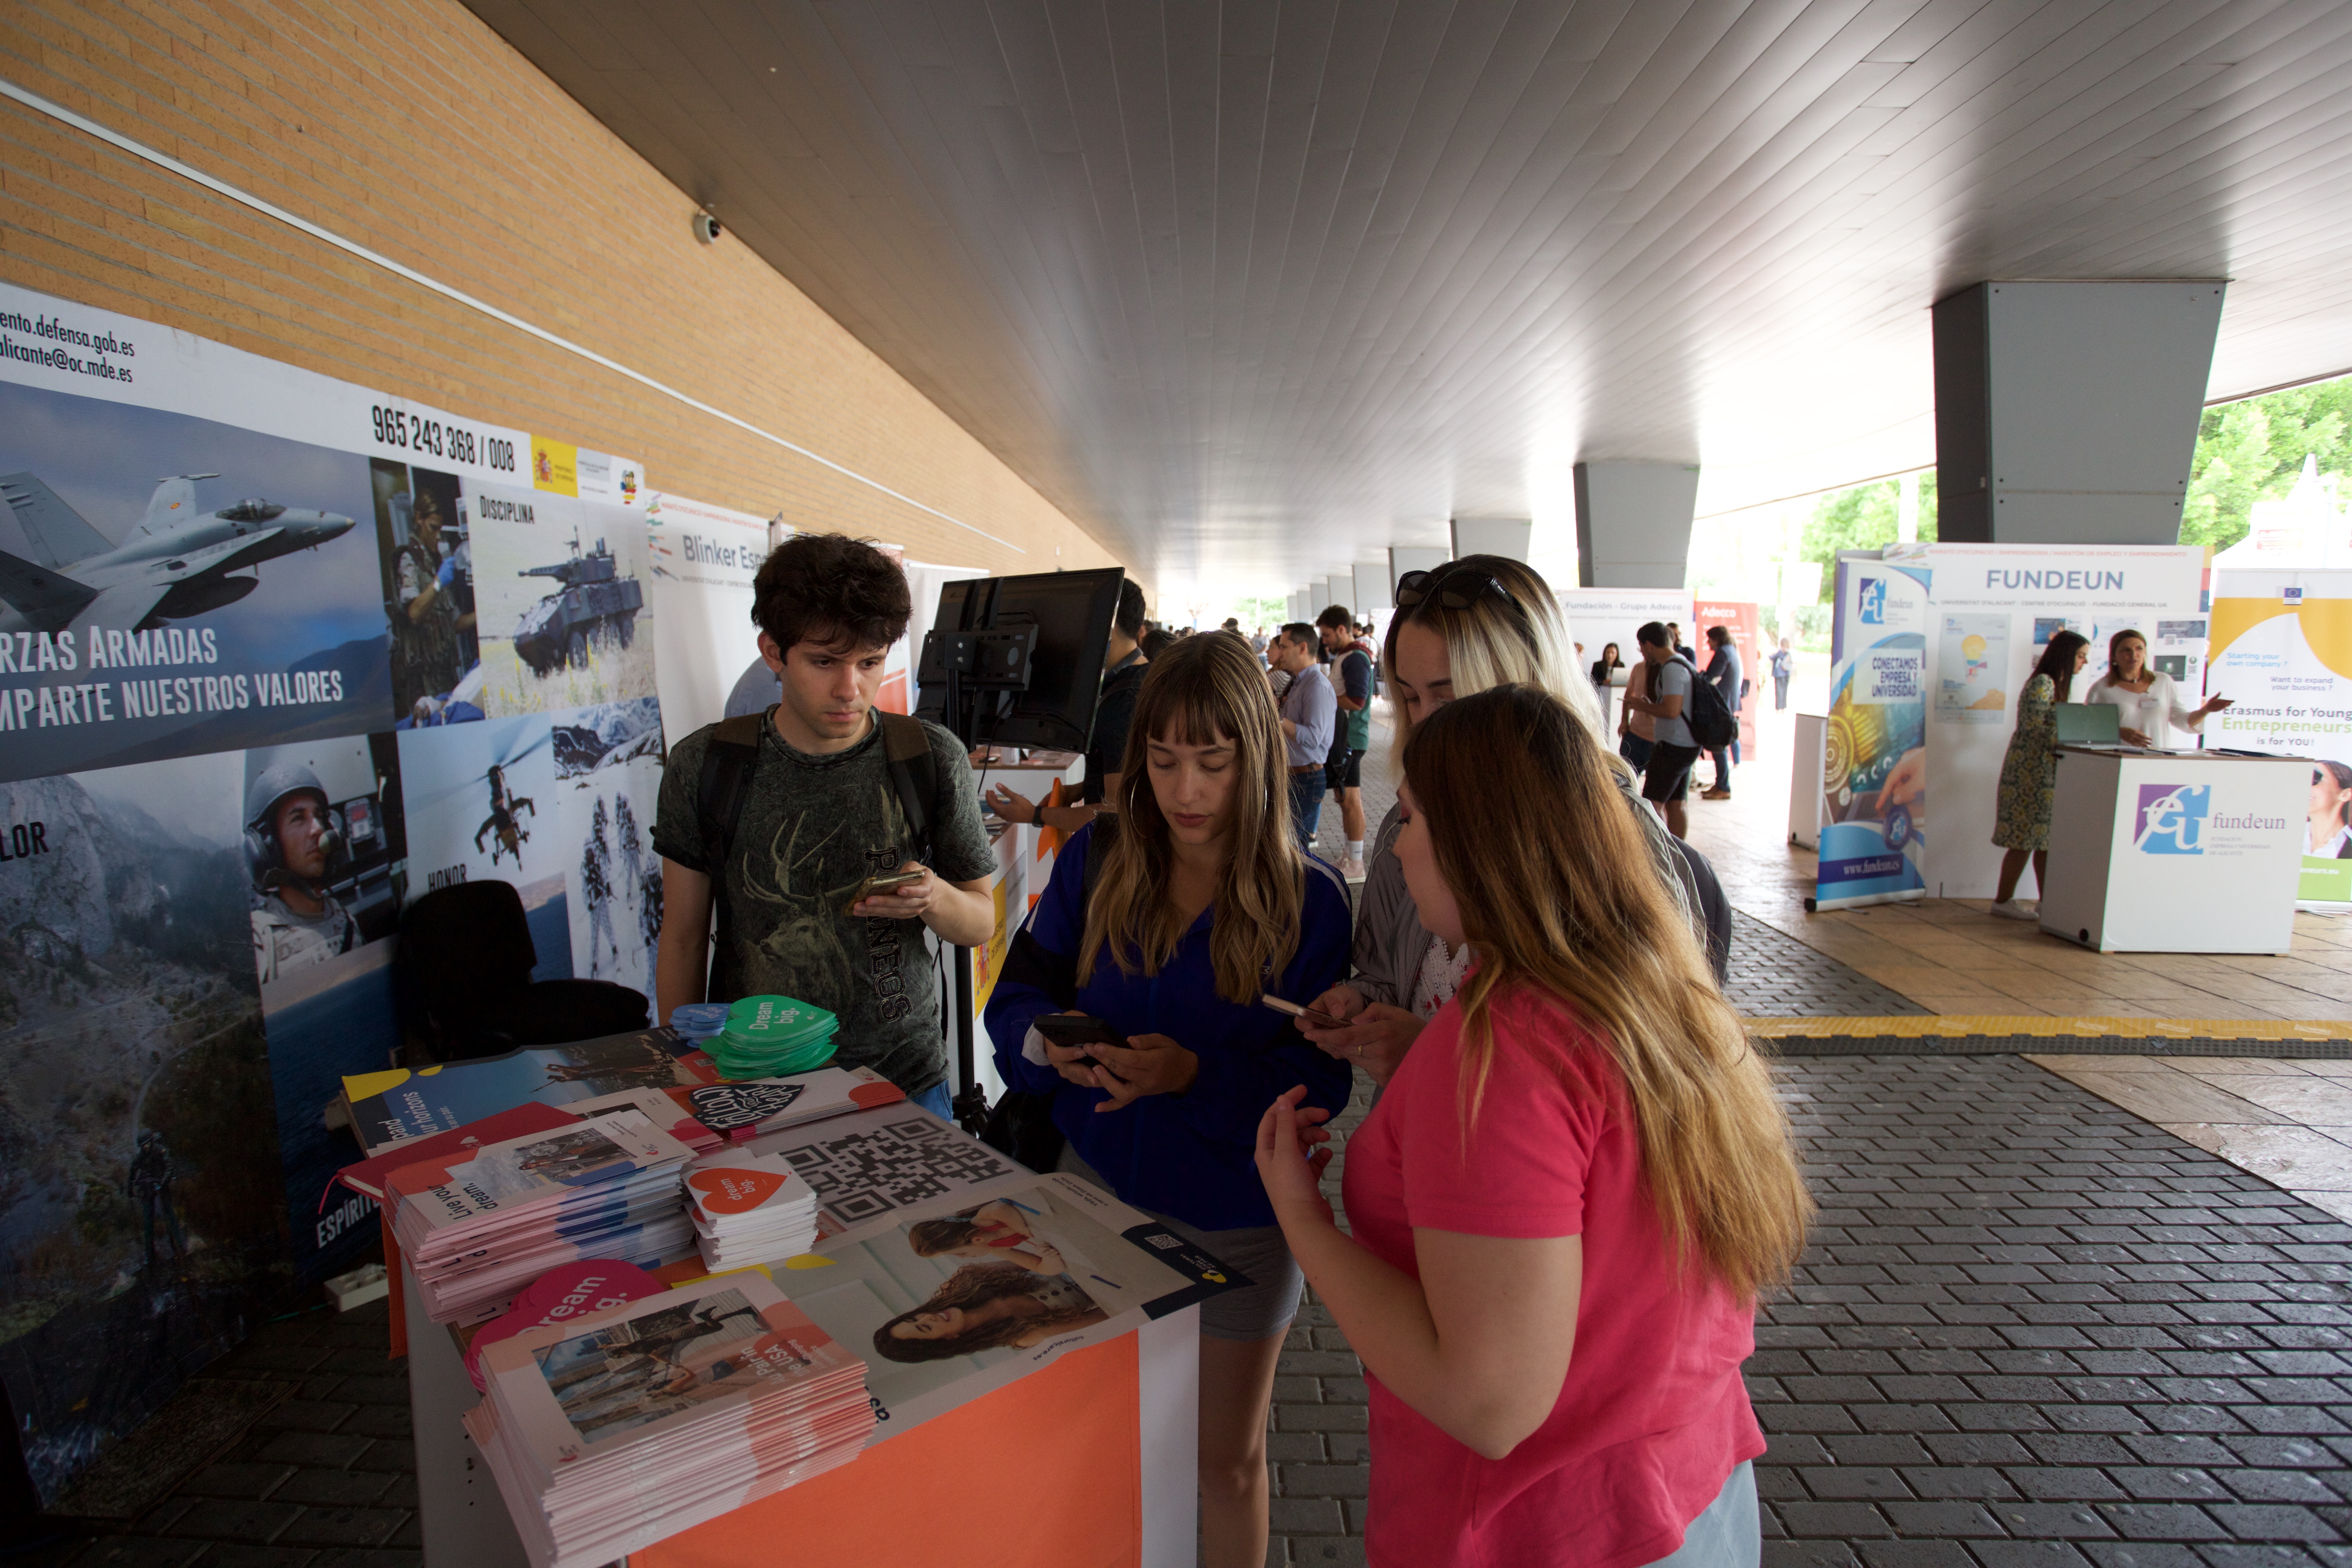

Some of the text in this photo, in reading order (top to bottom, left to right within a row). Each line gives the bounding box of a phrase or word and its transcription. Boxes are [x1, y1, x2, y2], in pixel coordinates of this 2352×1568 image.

[0, 312, 135, 357] ento.defensa.gob.es
[0, 334, 133, 383] licante@oc.mde.es
[371, 405, 408, 448] 965
[411, 415, 443, 457] 243
[446, 427, 476, 466] 368
[489, 438, 515, 472] 008
[479, 495, 535, 525] DISCIPLINA
[682, 534, 765, 570] Blinker Esp
[1986, 570, 2124, 590] FUNDEUN
[1566, 601, 1613, 610] Fundación
[1620, 602, 1647, 611] Grupo
[1650, 602, 1683, 611] Adecco
[1701, 606, 1737, 618] Adecco
[0, 625, 218, 673] RZAS ARMADAS
[1873, 657, 1917, 669] CONECTAMOS
[1880, 672, 1911, 683] EMPRESA
[0, 670, 343, 731] MPARTE NUESTROS VALORES
[1872, 685, 1917, 697] UNIVERSIDAD
[2221, 717, 2352, 735] Entrepreneurs
[2222, 706, 2352, 722] Erasmus for Young
[2212, 812, 2286, 830] fundeun
[0, 822, 49, 862] LOR
[428, 864, 468, 893] HONOR
[863, 846, 913, 1023] PNEOS
[748, 1002, 800, 1030] Dream big.
[402, 1091, 439, 1134] ur horizons
[377, 1118, 415, 1141] pand
[463, 1183, 499, 1211] dream.
[720, 1178, 756, 1200] dream big.
[426, 1184, 474, 1220] Live your
[1180, 1253, 1206, 1270] CULTURAL
[740, 1347, 758, 1359] in
[764, 1344, 794, 1366] USA
[1032, 1336, 1084, 1361] culturalcare.es
[748, 1356, 772, 1376] Pair
